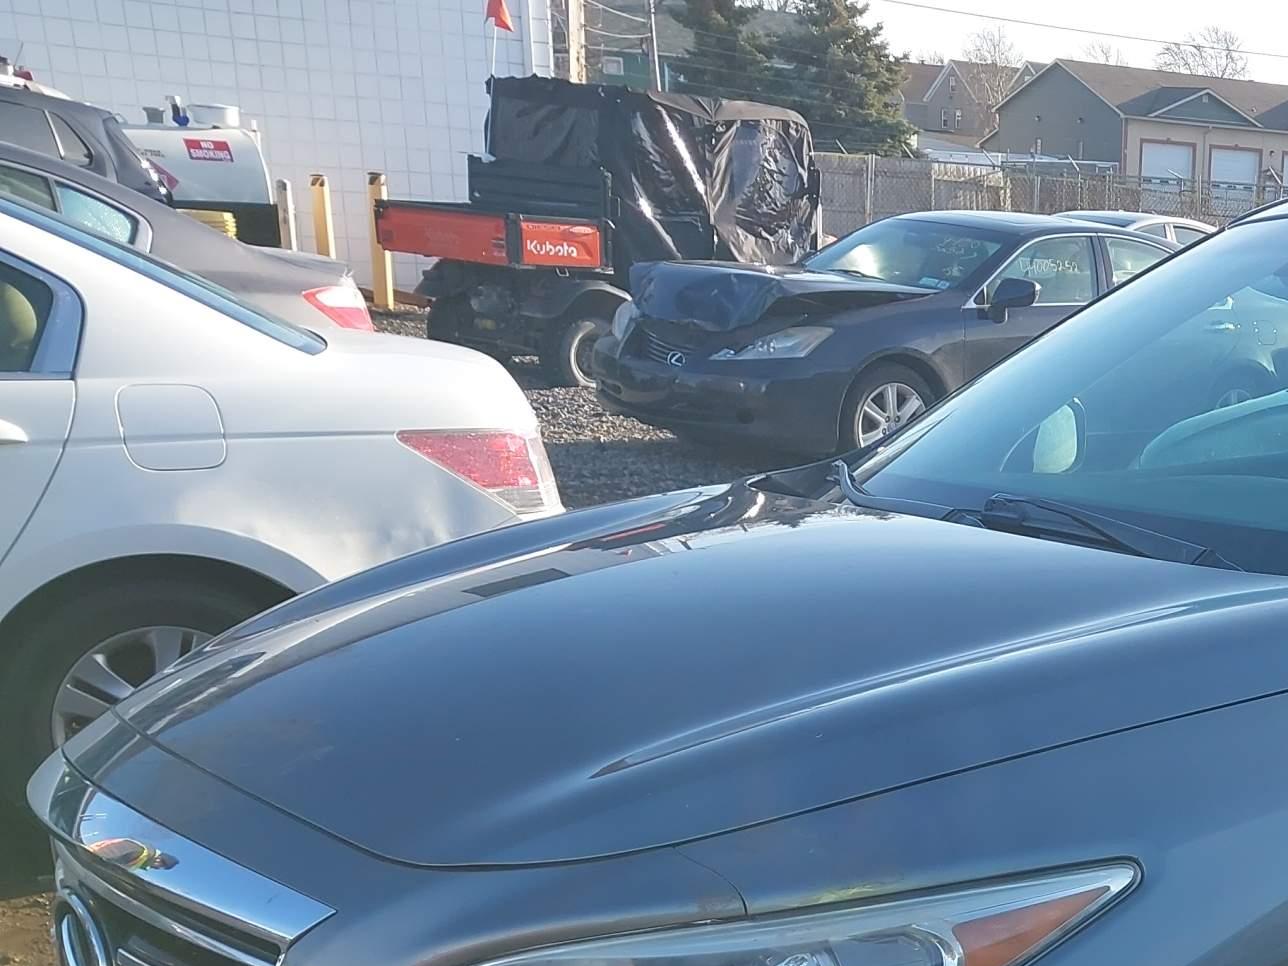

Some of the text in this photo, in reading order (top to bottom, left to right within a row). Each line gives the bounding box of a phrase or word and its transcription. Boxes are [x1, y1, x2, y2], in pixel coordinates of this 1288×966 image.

[200, 141, 214, 149] NO
[190, 149, 230, 159] SMOKING
[527, 240, 577, 257] Kubota
